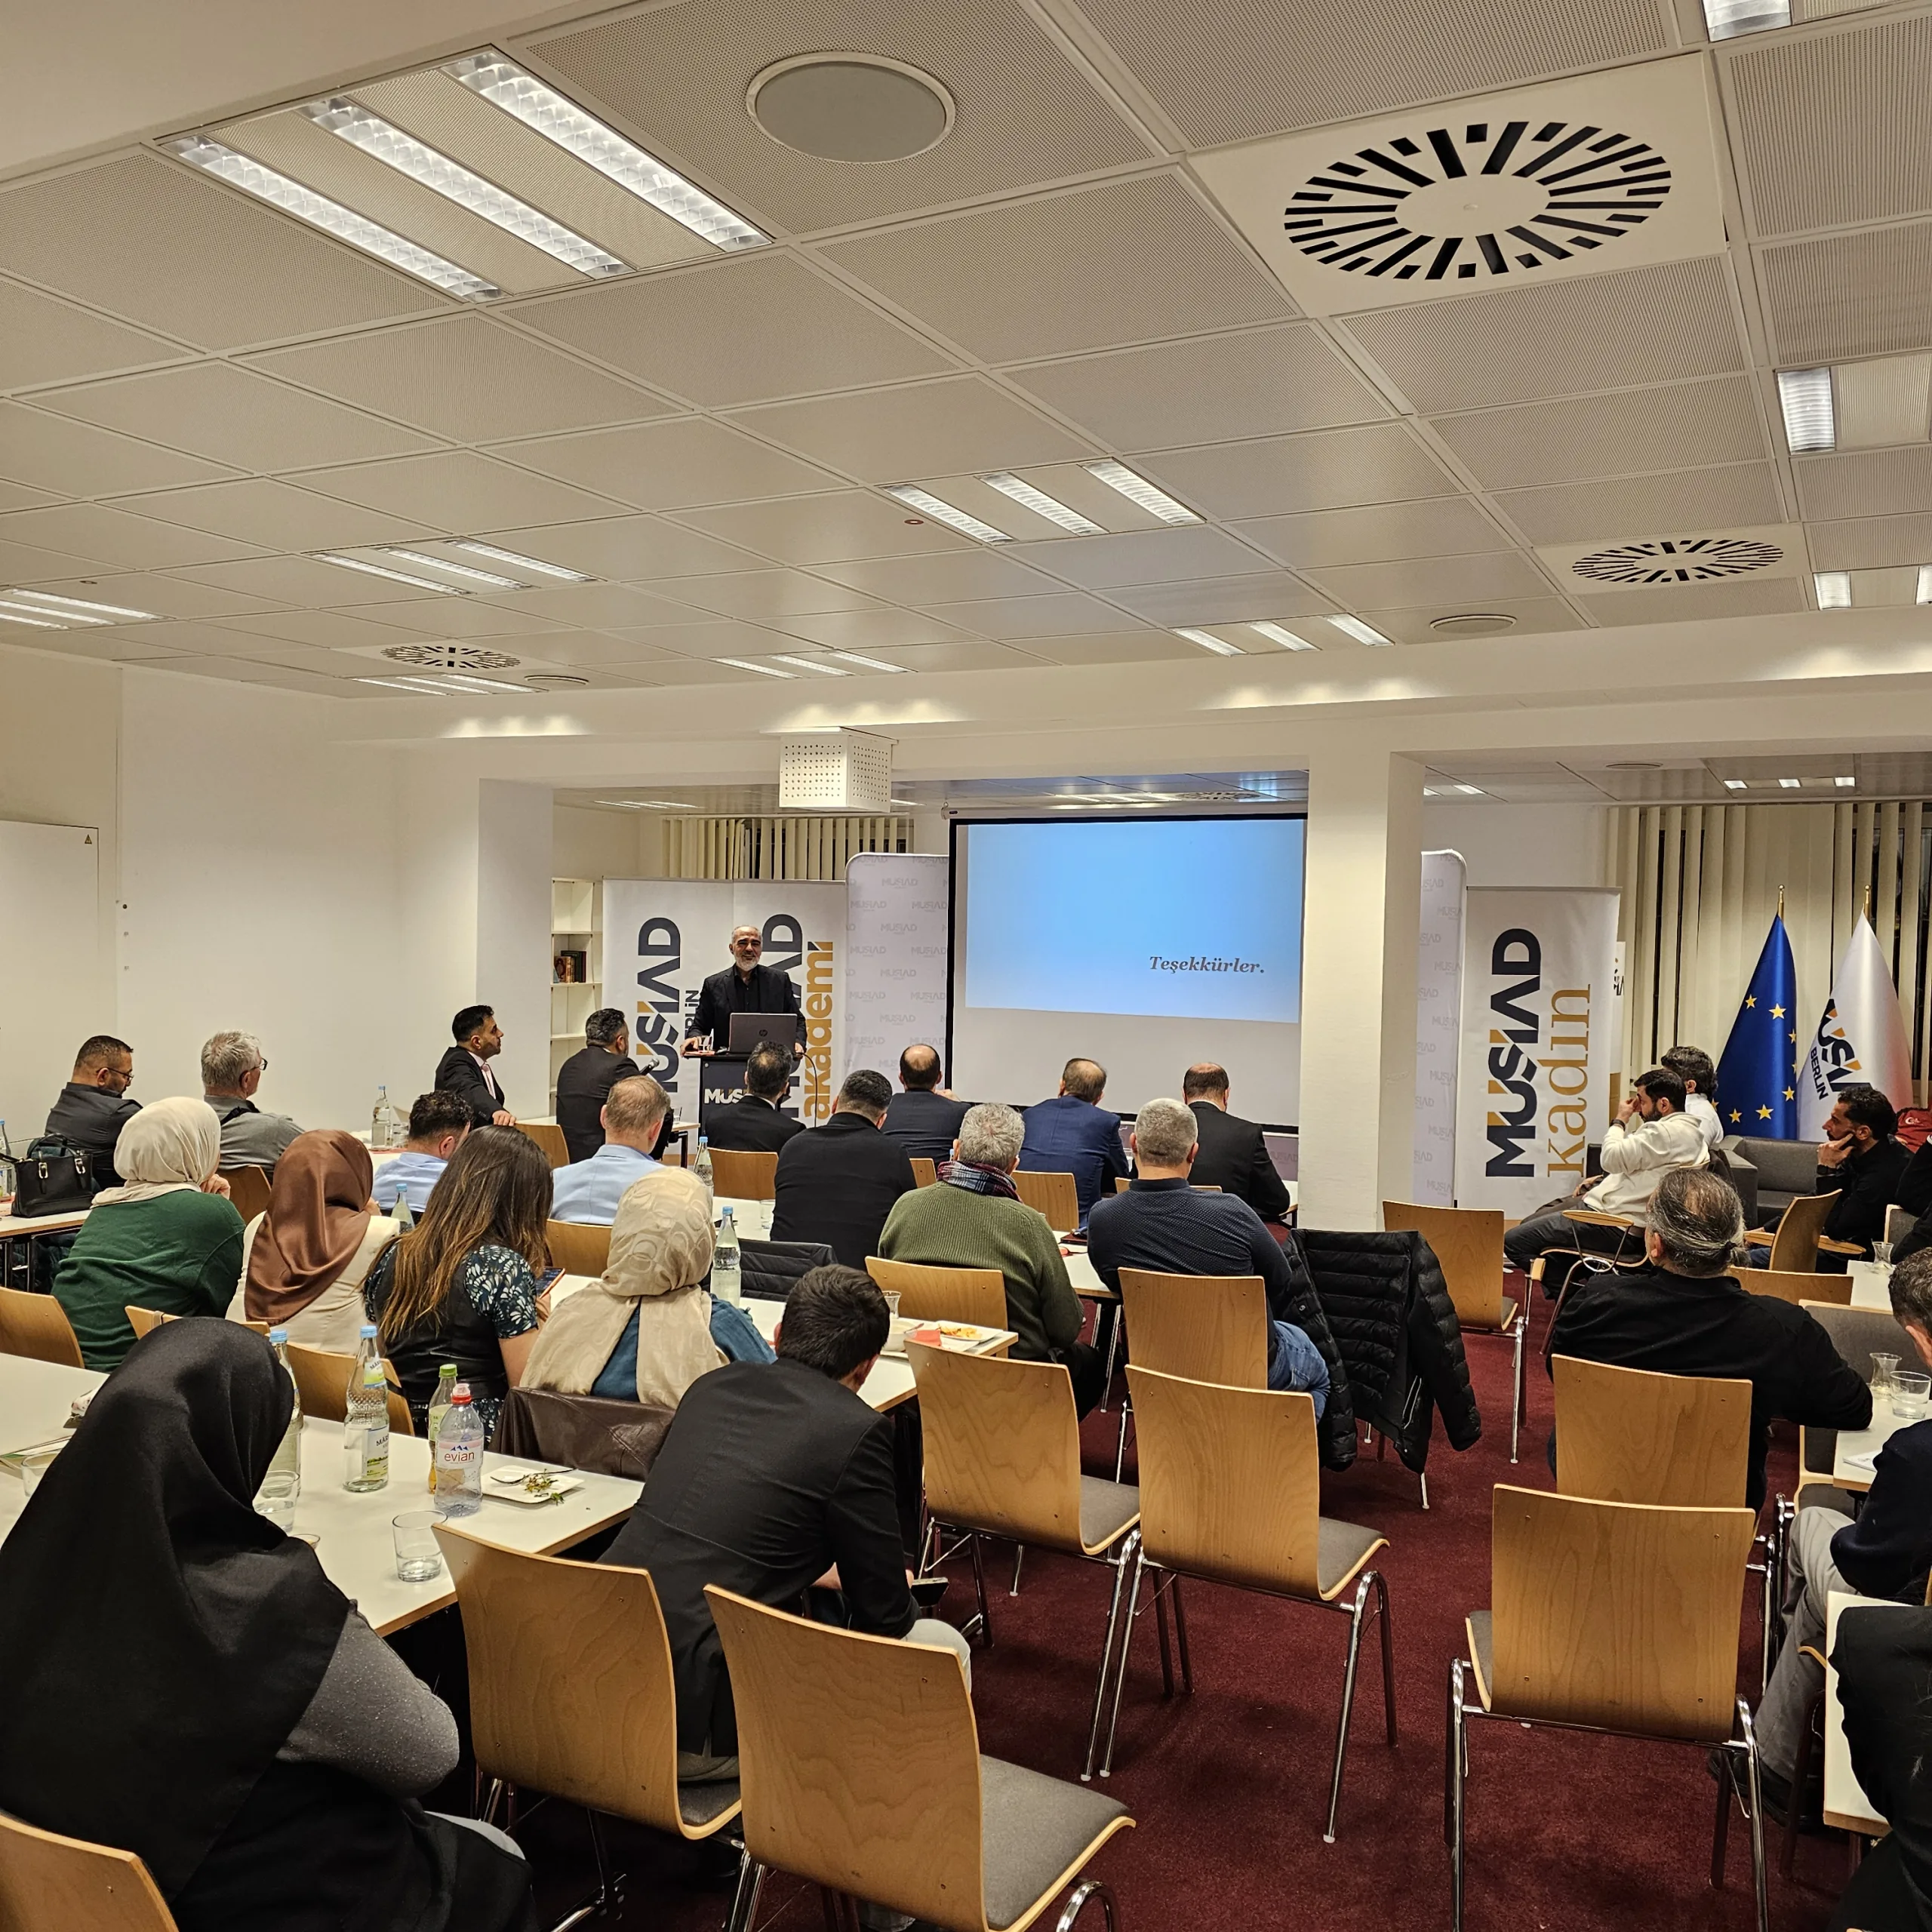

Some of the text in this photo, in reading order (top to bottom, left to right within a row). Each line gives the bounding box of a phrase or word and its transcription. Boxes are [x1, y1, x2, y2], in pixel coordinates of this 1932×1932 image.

[1149, 955, 1265, 974] Teşekkürler.
[1537, 984, 1591, 1177] kadın
[1810, 1046, 1829, 1100] BERLIN
[444, 1451, 475, 1462] evian
